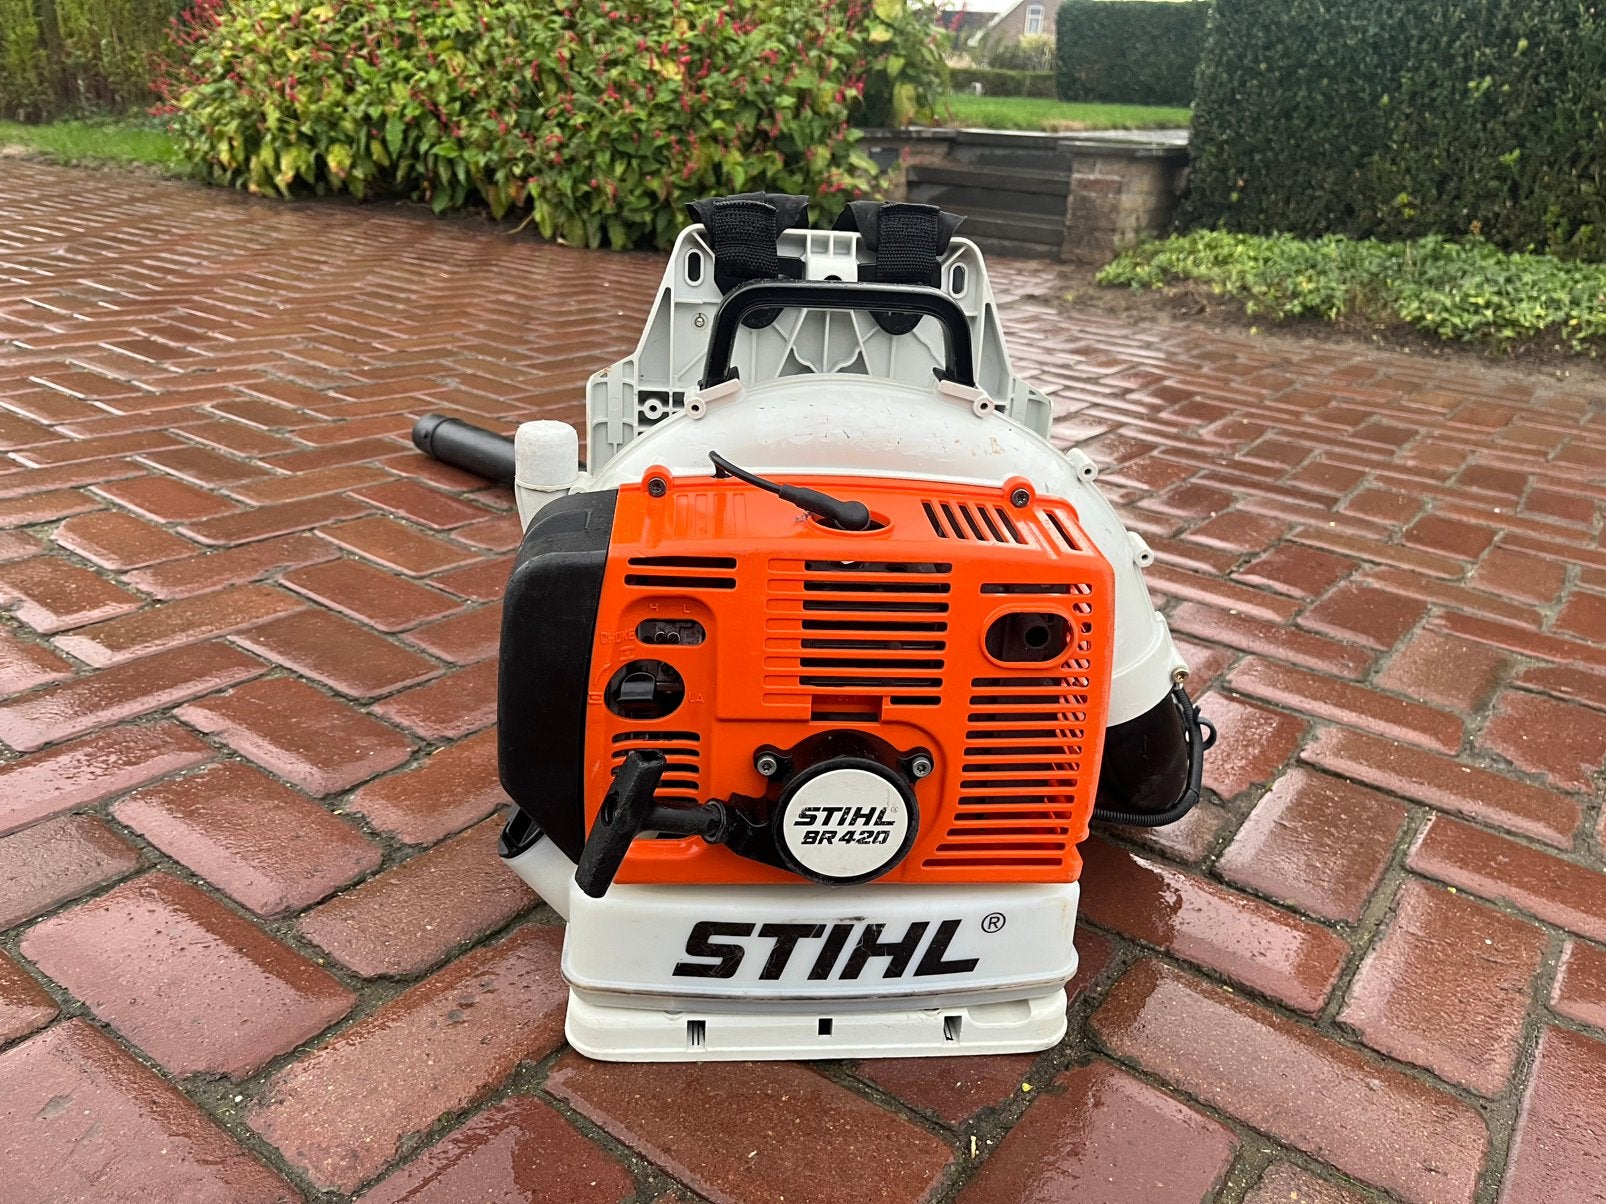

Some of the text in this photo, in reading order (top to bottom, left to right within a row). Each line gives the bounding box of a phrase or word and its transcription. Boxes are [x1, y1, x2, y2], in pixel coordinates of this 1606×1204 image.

[793, 806, 896, 827] STIHL
[800, 830, 891, 845] BR 420
